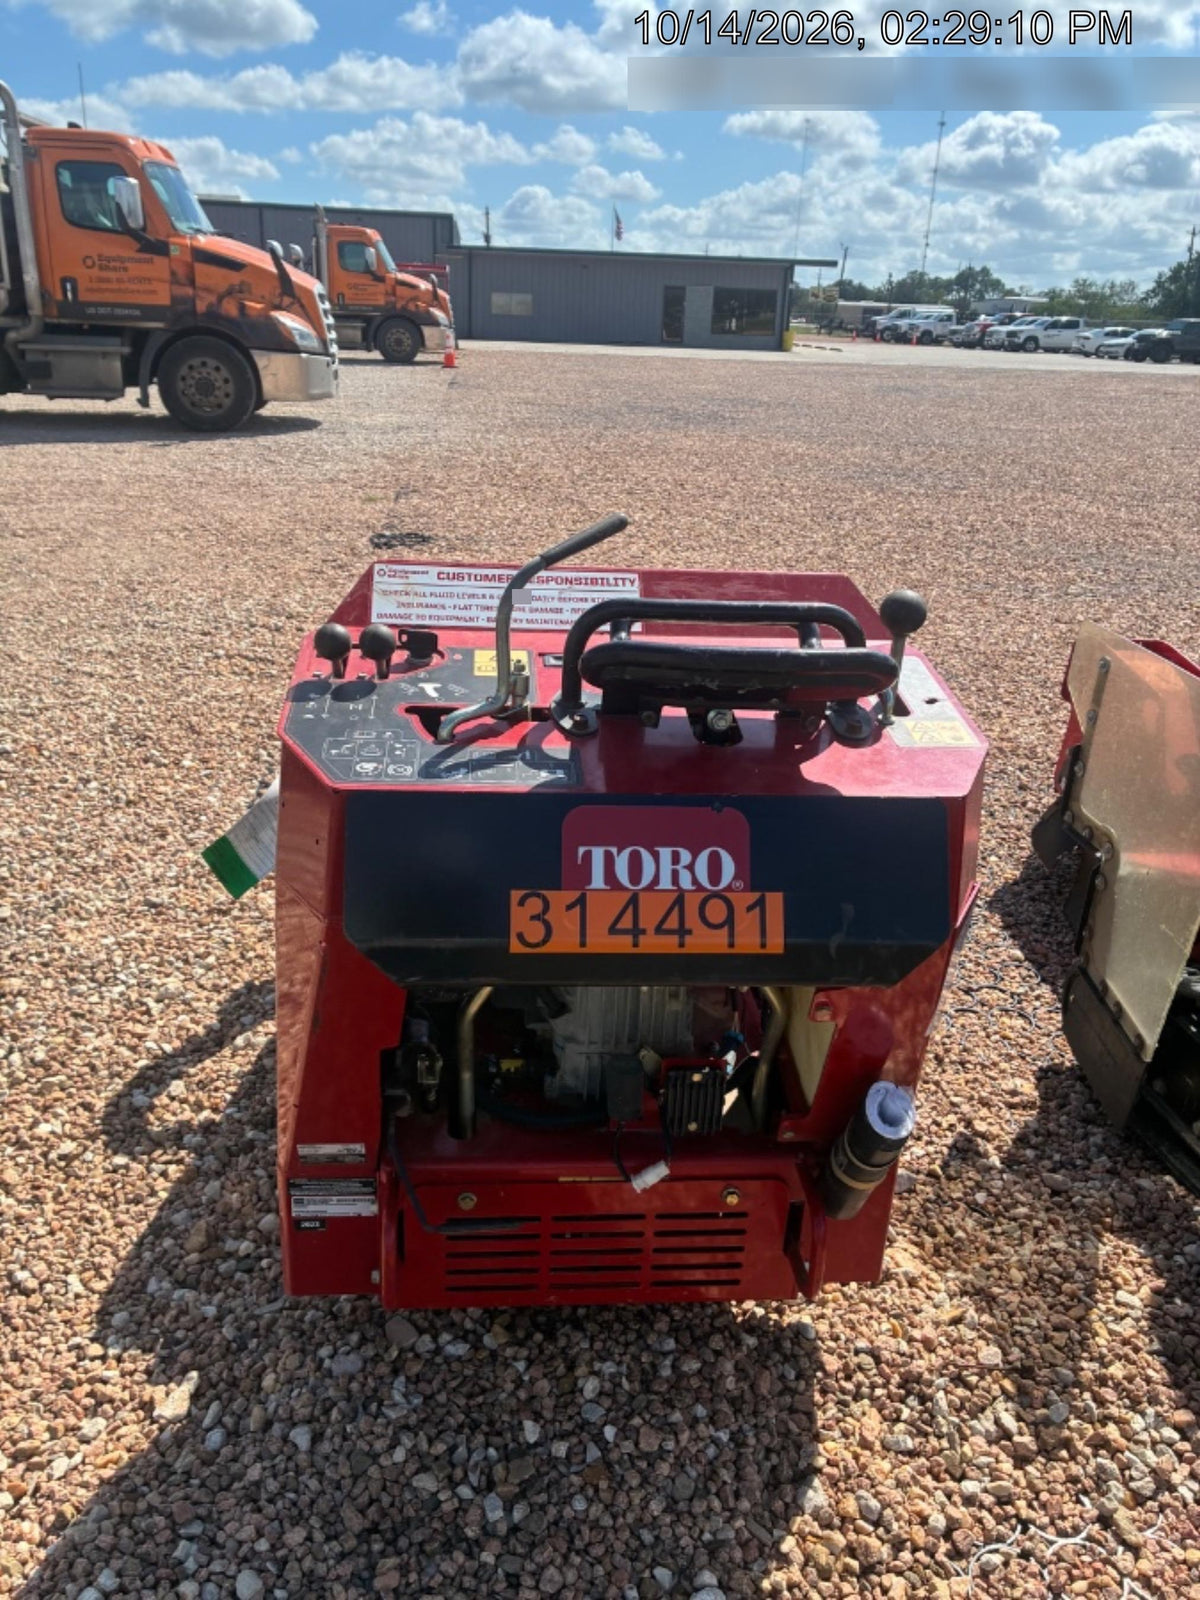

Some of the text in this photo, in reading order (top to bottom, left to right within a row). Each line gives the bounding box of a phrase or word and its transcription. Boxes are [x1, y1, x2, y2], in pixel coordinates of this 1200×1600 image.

[97, 253, 154, 265] Equipment
[429, 591, 456, 599] FLUID
[457, 592, 487, 600] LEVELS
[453, 603, 473, 611] FLAT
[429, 614, 480, 623] EQUIPMENT
[515, 891, 768, 949] 314491
